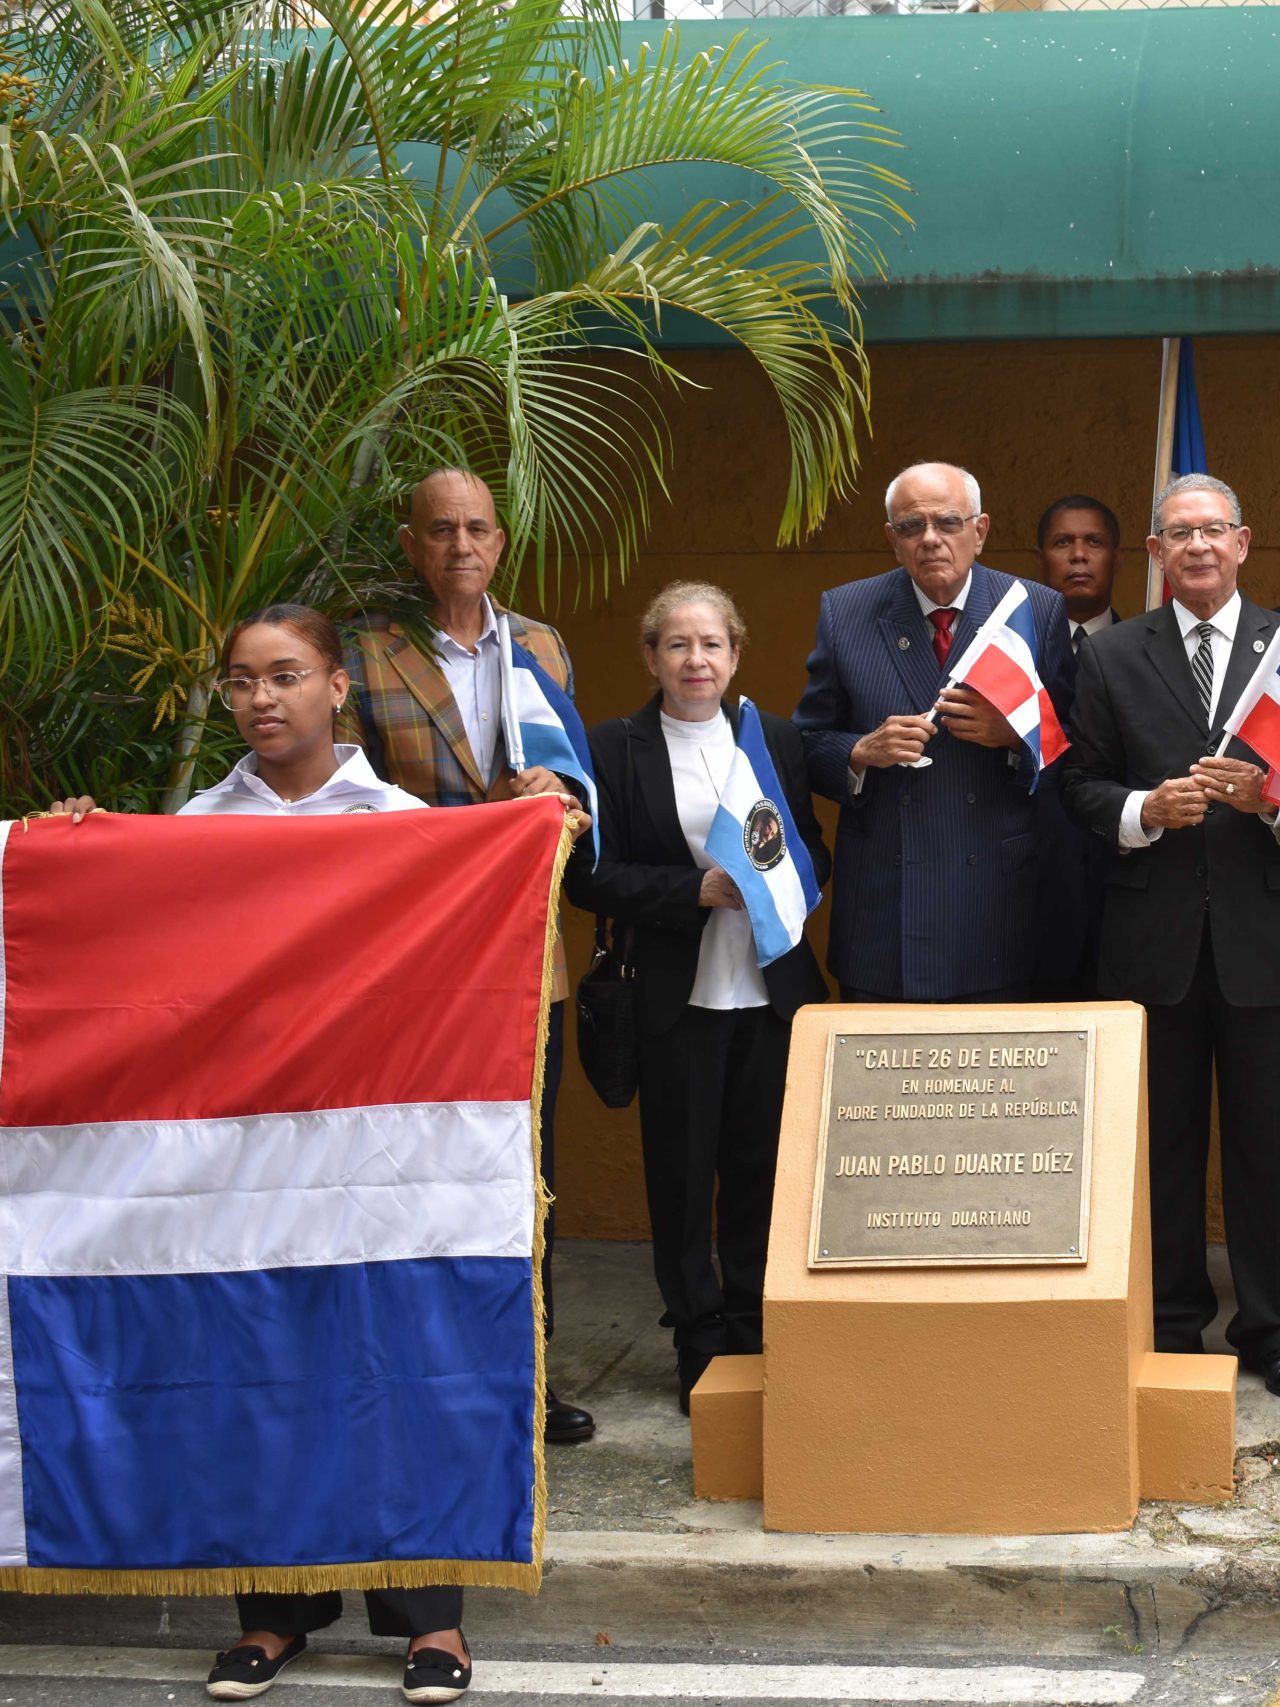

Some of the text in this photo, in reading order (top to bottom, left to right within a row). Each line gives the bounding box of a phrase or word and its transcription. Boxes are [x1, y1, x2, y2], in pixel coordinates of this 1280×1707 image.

[856, 1046, 1059, 1069] "CALLE 26 DE ENERO"
[901, 1078, 1016, 1095] EN HOMENAJE AL
[837, 1097, 1078, 1121] PADRE FUNDADOR DE LA REPÚBLICA
[835, 1145, 1074, 1177] JUAN PABLO DUARTE DÍEZ
[867, 1210, 1031, 1229] INSTITUTO DUARTIANO
